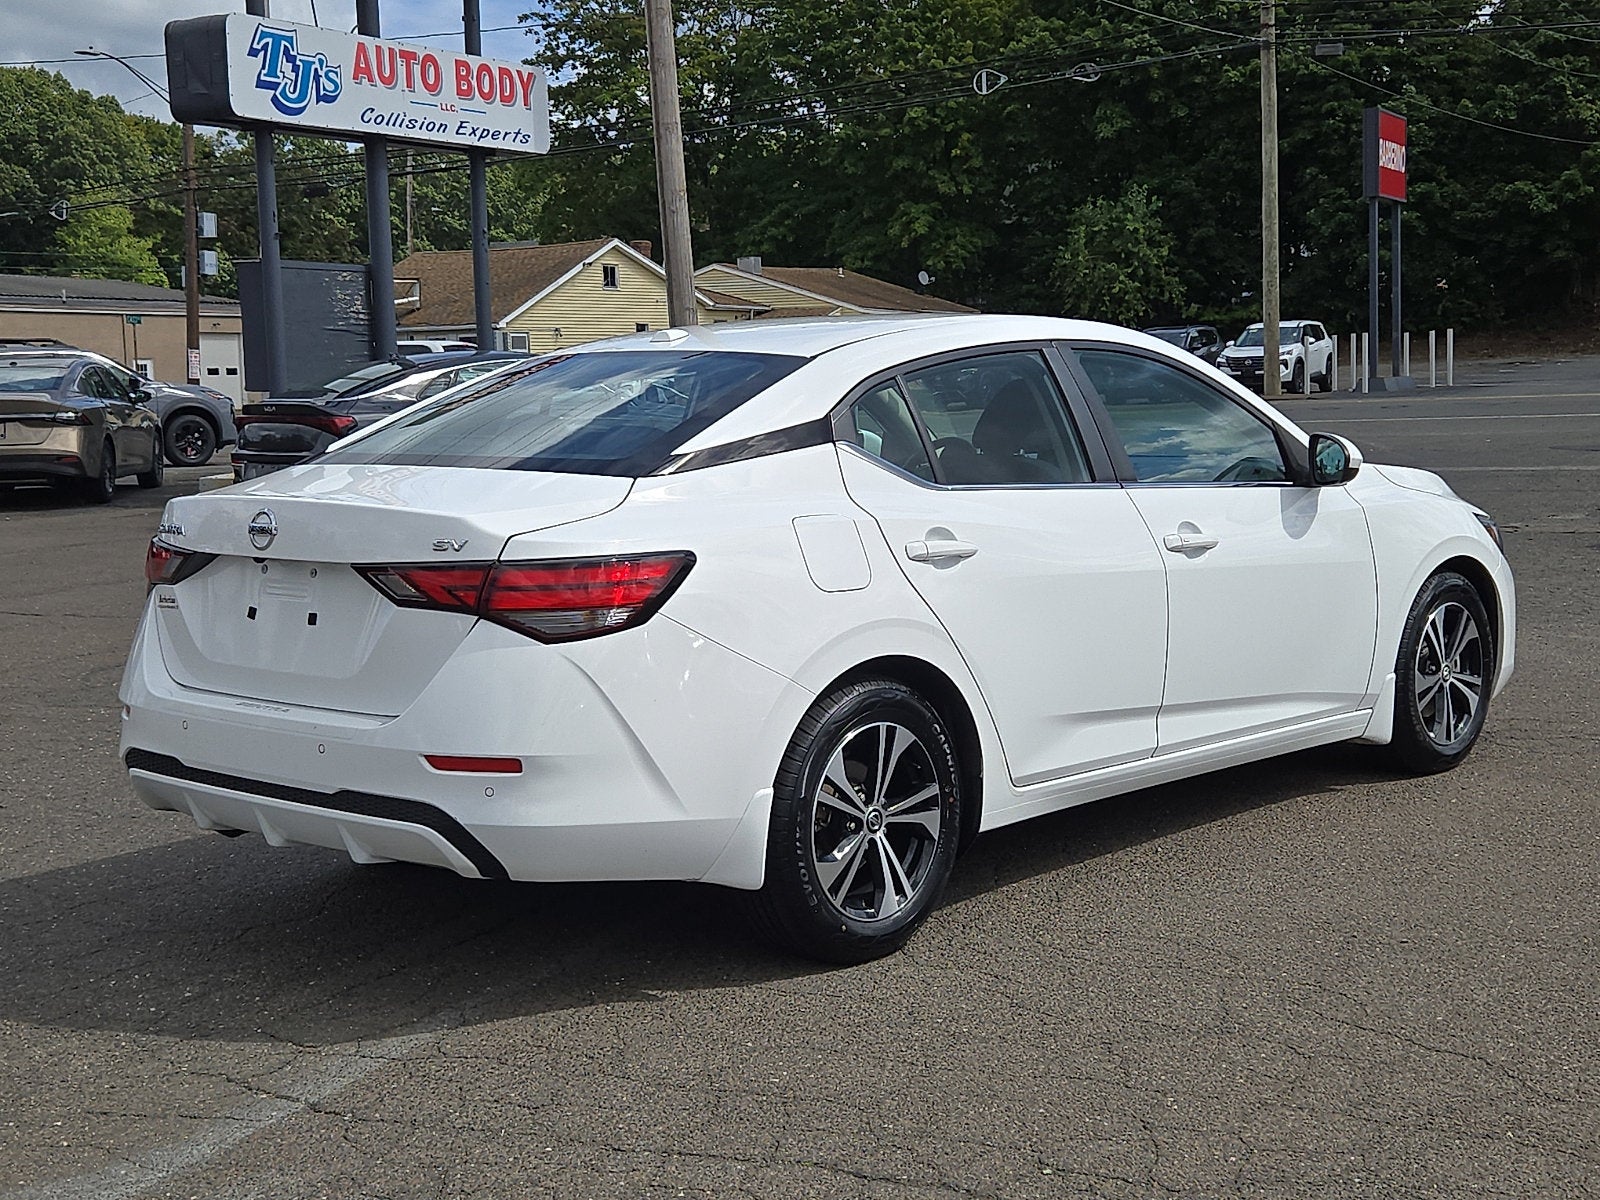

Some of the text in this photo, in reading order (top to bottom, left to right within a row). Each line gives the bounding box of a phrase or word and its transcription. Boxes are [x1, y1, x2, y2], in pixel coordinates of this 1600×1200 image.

[247, 22, 342, 116] TJ's
[352, 41, 536, 110] AUTO BODY
[360, 107, 532, 144] Collision Experts
[439, 102, 459, 113] LLC.
[432, 538, 469, 552] SV
